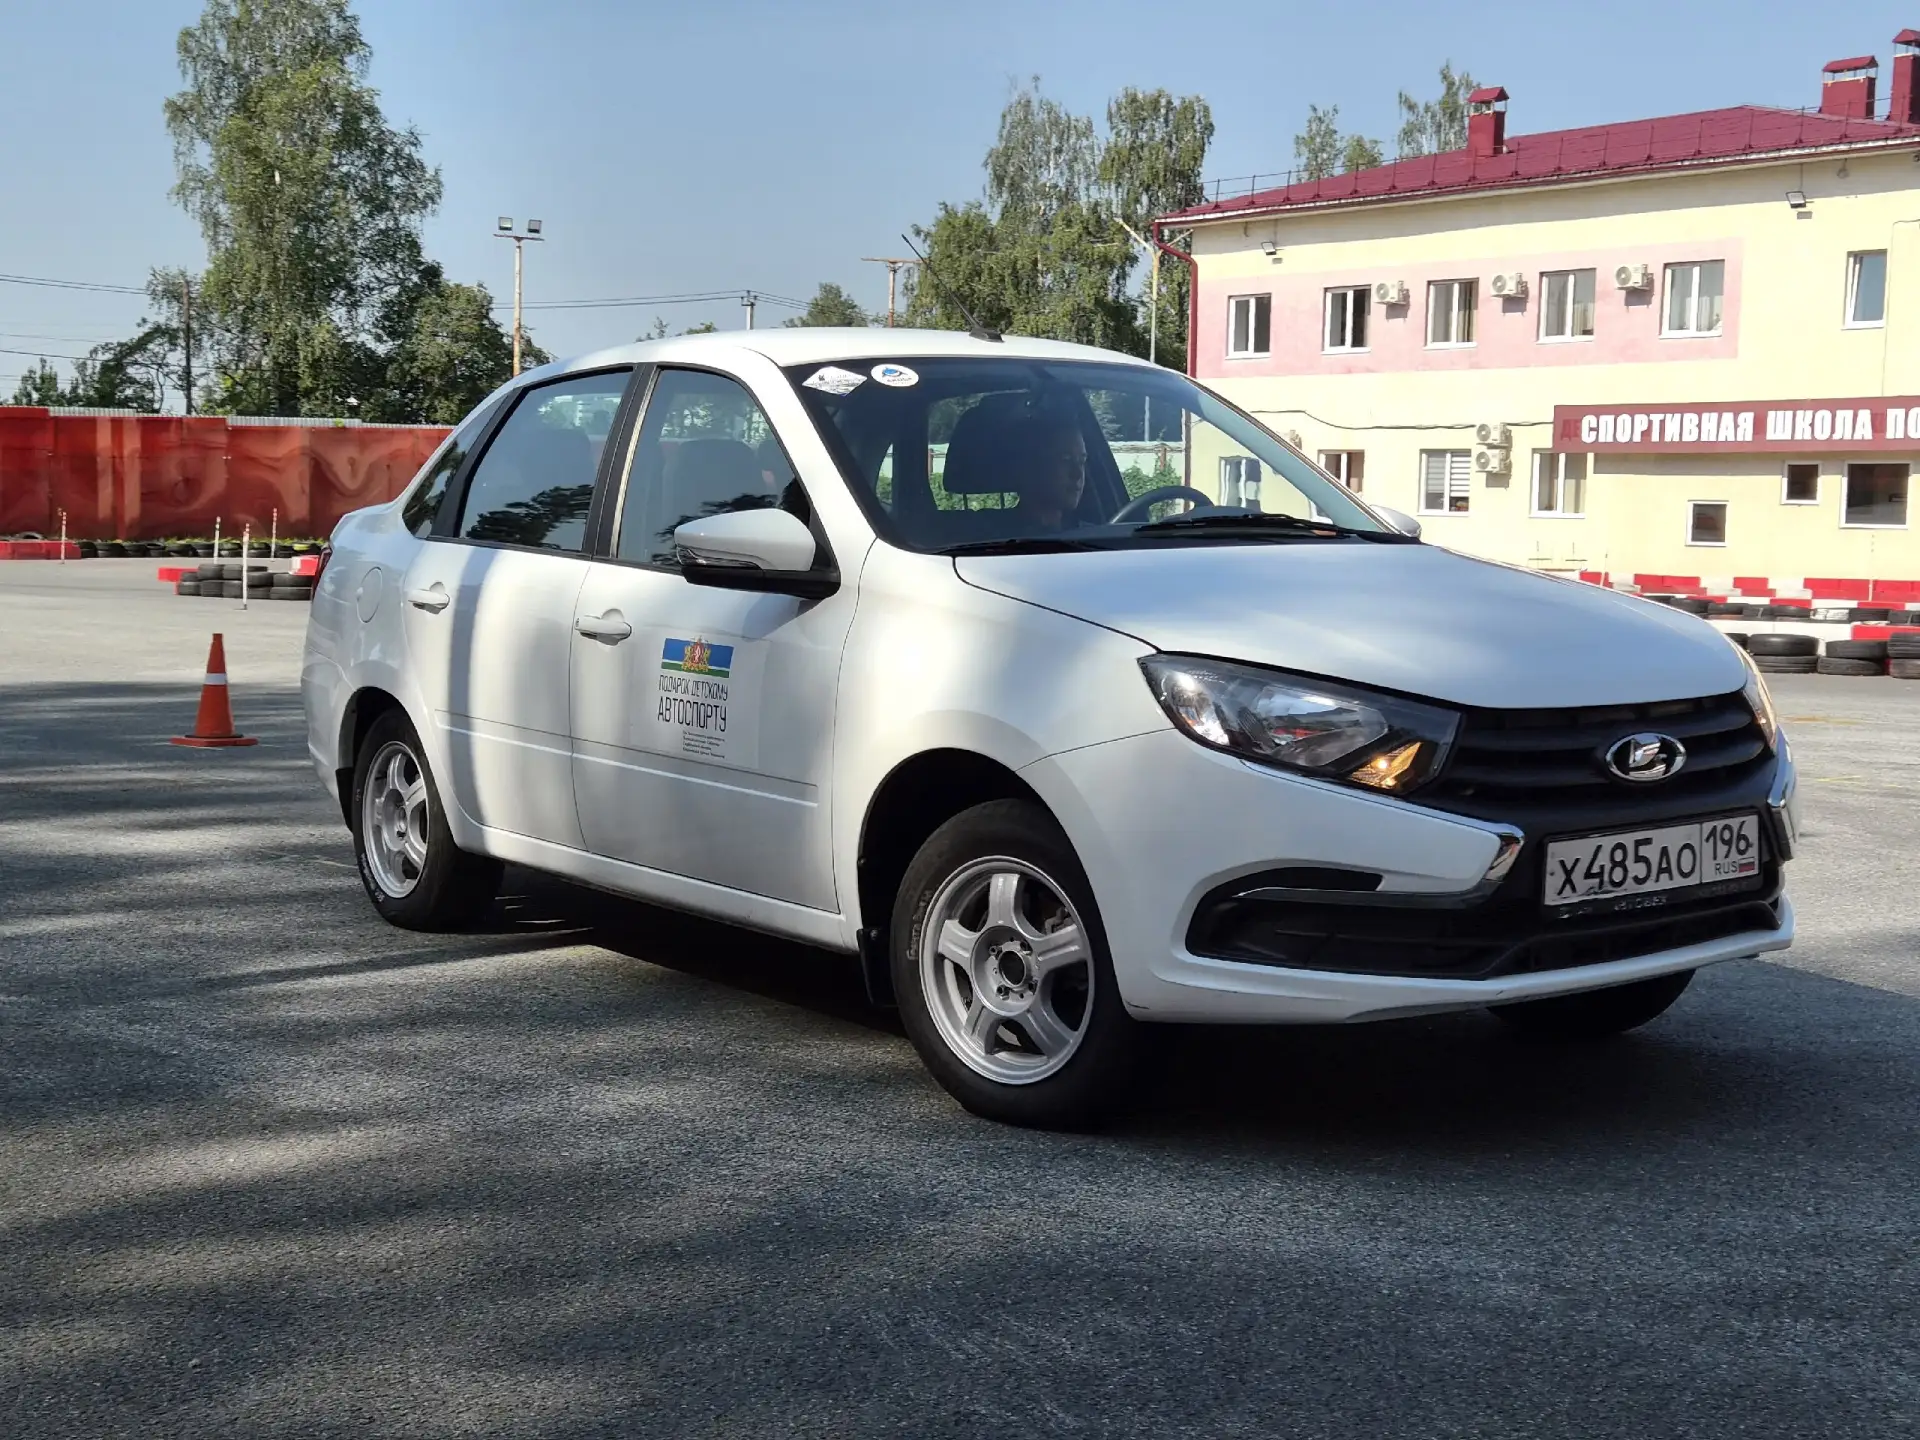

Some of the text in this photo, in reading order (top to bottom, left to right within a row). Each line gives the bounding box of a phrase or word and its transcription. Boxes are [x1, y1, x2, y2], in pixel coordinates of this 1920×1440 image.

[1581, 411, 1755, 444] СПОРТИВНАЯ
[1766, 408, 1873, 442] ШКОЛА
[659, 674, 728, 702] ПОДАРОК ДЕТСКОМУ
[657, 695, 727, 732] АВТОСПОРТУ
[1705, 819, 1750, 861] 196
[1714, 860, 1738, 875] RUS
